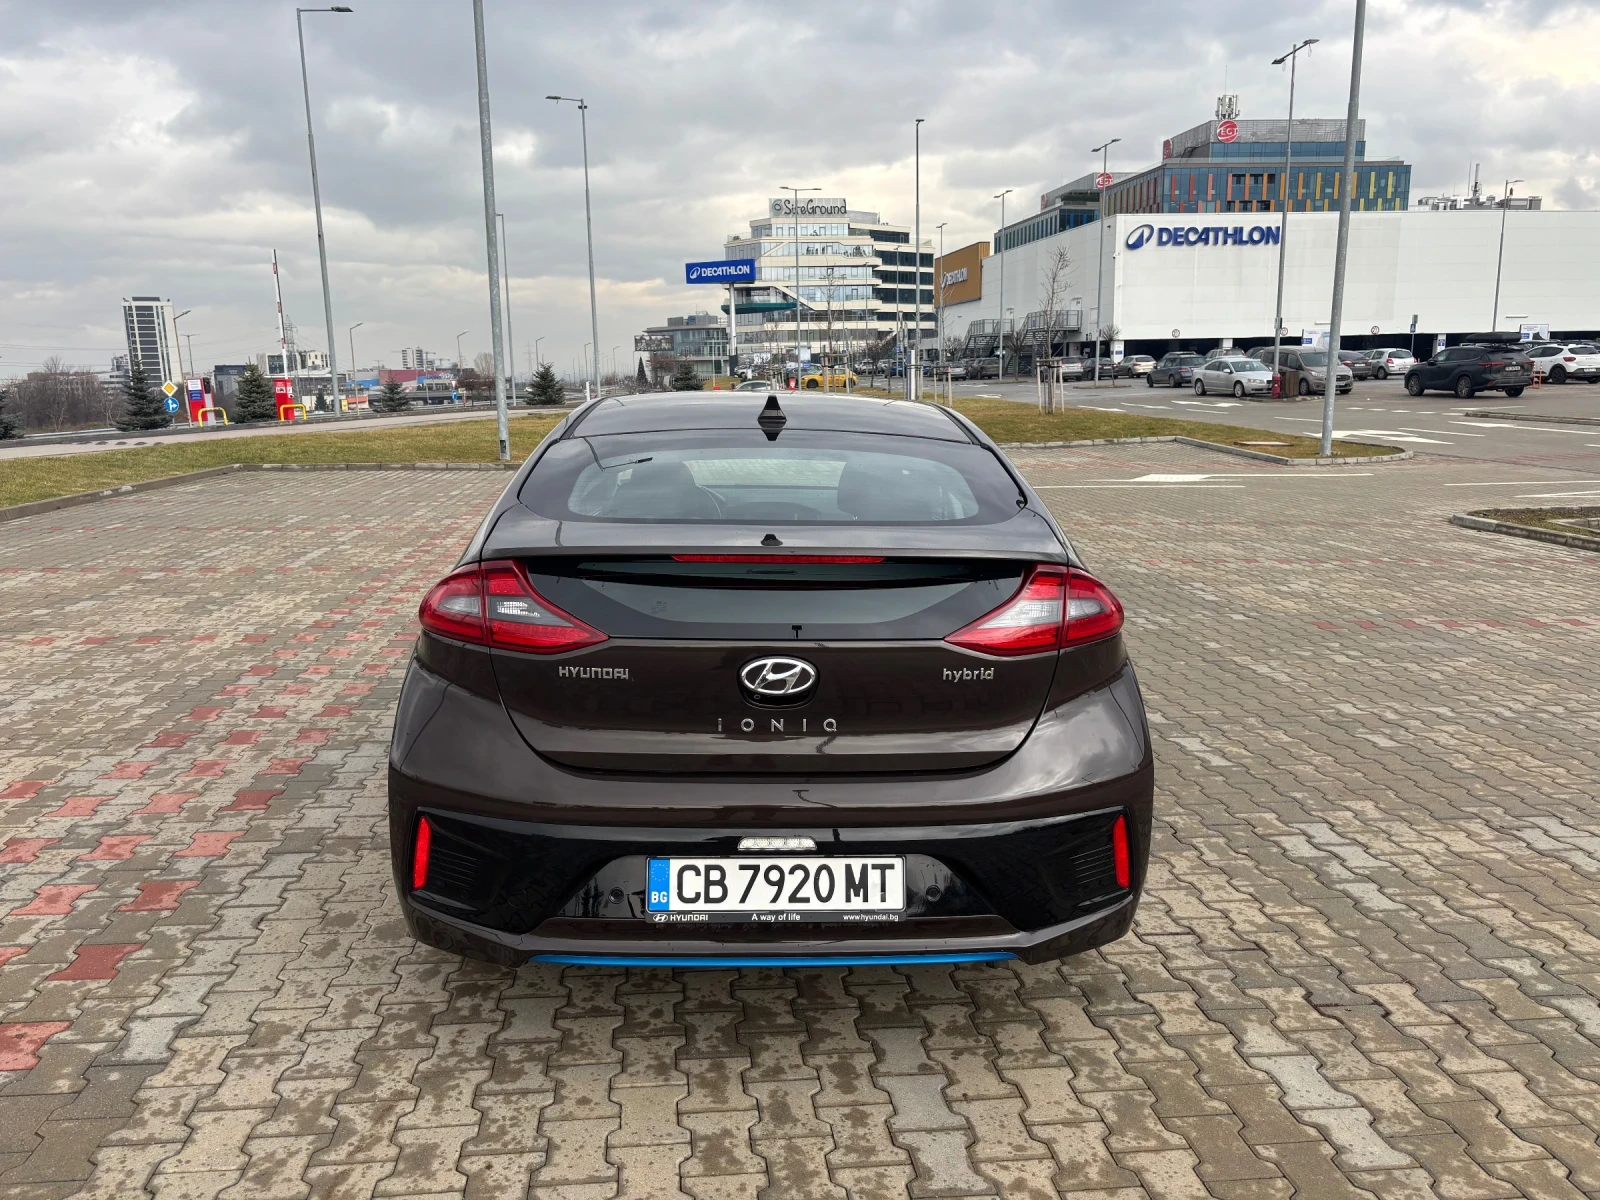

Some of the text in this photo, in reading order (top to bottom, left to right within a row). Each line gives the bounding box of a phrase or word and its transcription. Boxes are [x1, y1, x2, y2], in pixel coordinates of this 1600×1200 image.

[783, 199, 848, 215] SiteGround
[1157, 226, 1281, 247] DECATHLON
[701, 265, 751, 277] DECATHLON
[558, 666, 629, 680] HYUNDAI
[942, 667, 995, 683] hybrid
[651, 863, 895, 904] BG CB 7920 MT
[669, 914, 709, 922] HYUNDAI
[751, 913, 801, 922] A way of life
[843, 913, 899, 921] www.hyundai.bg
